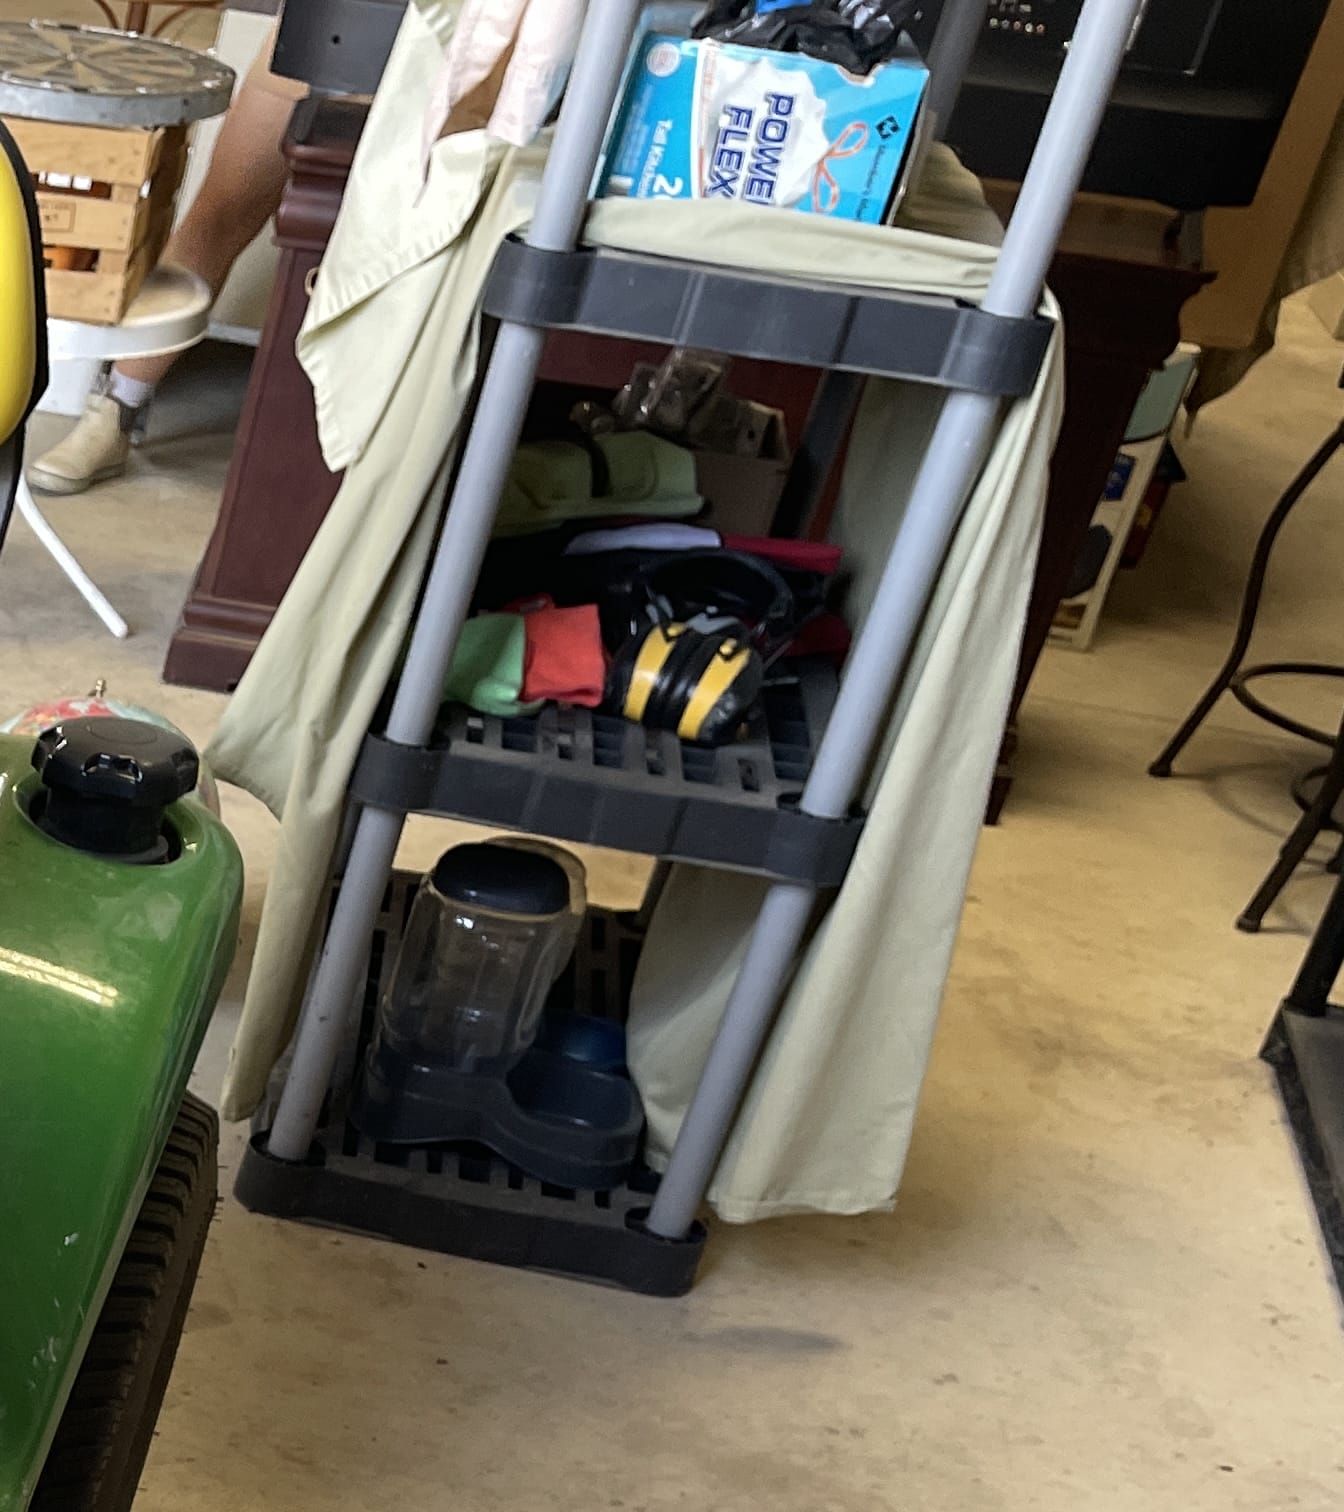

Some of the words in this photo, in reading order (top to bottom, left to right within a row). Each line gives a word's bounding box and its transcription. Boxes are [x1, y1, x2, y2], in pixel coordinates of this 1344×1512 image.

[653, 174, 683, 200] 2
[705, 104, 754, 198] FLEX
[741, 90, 796, 205] POWE
